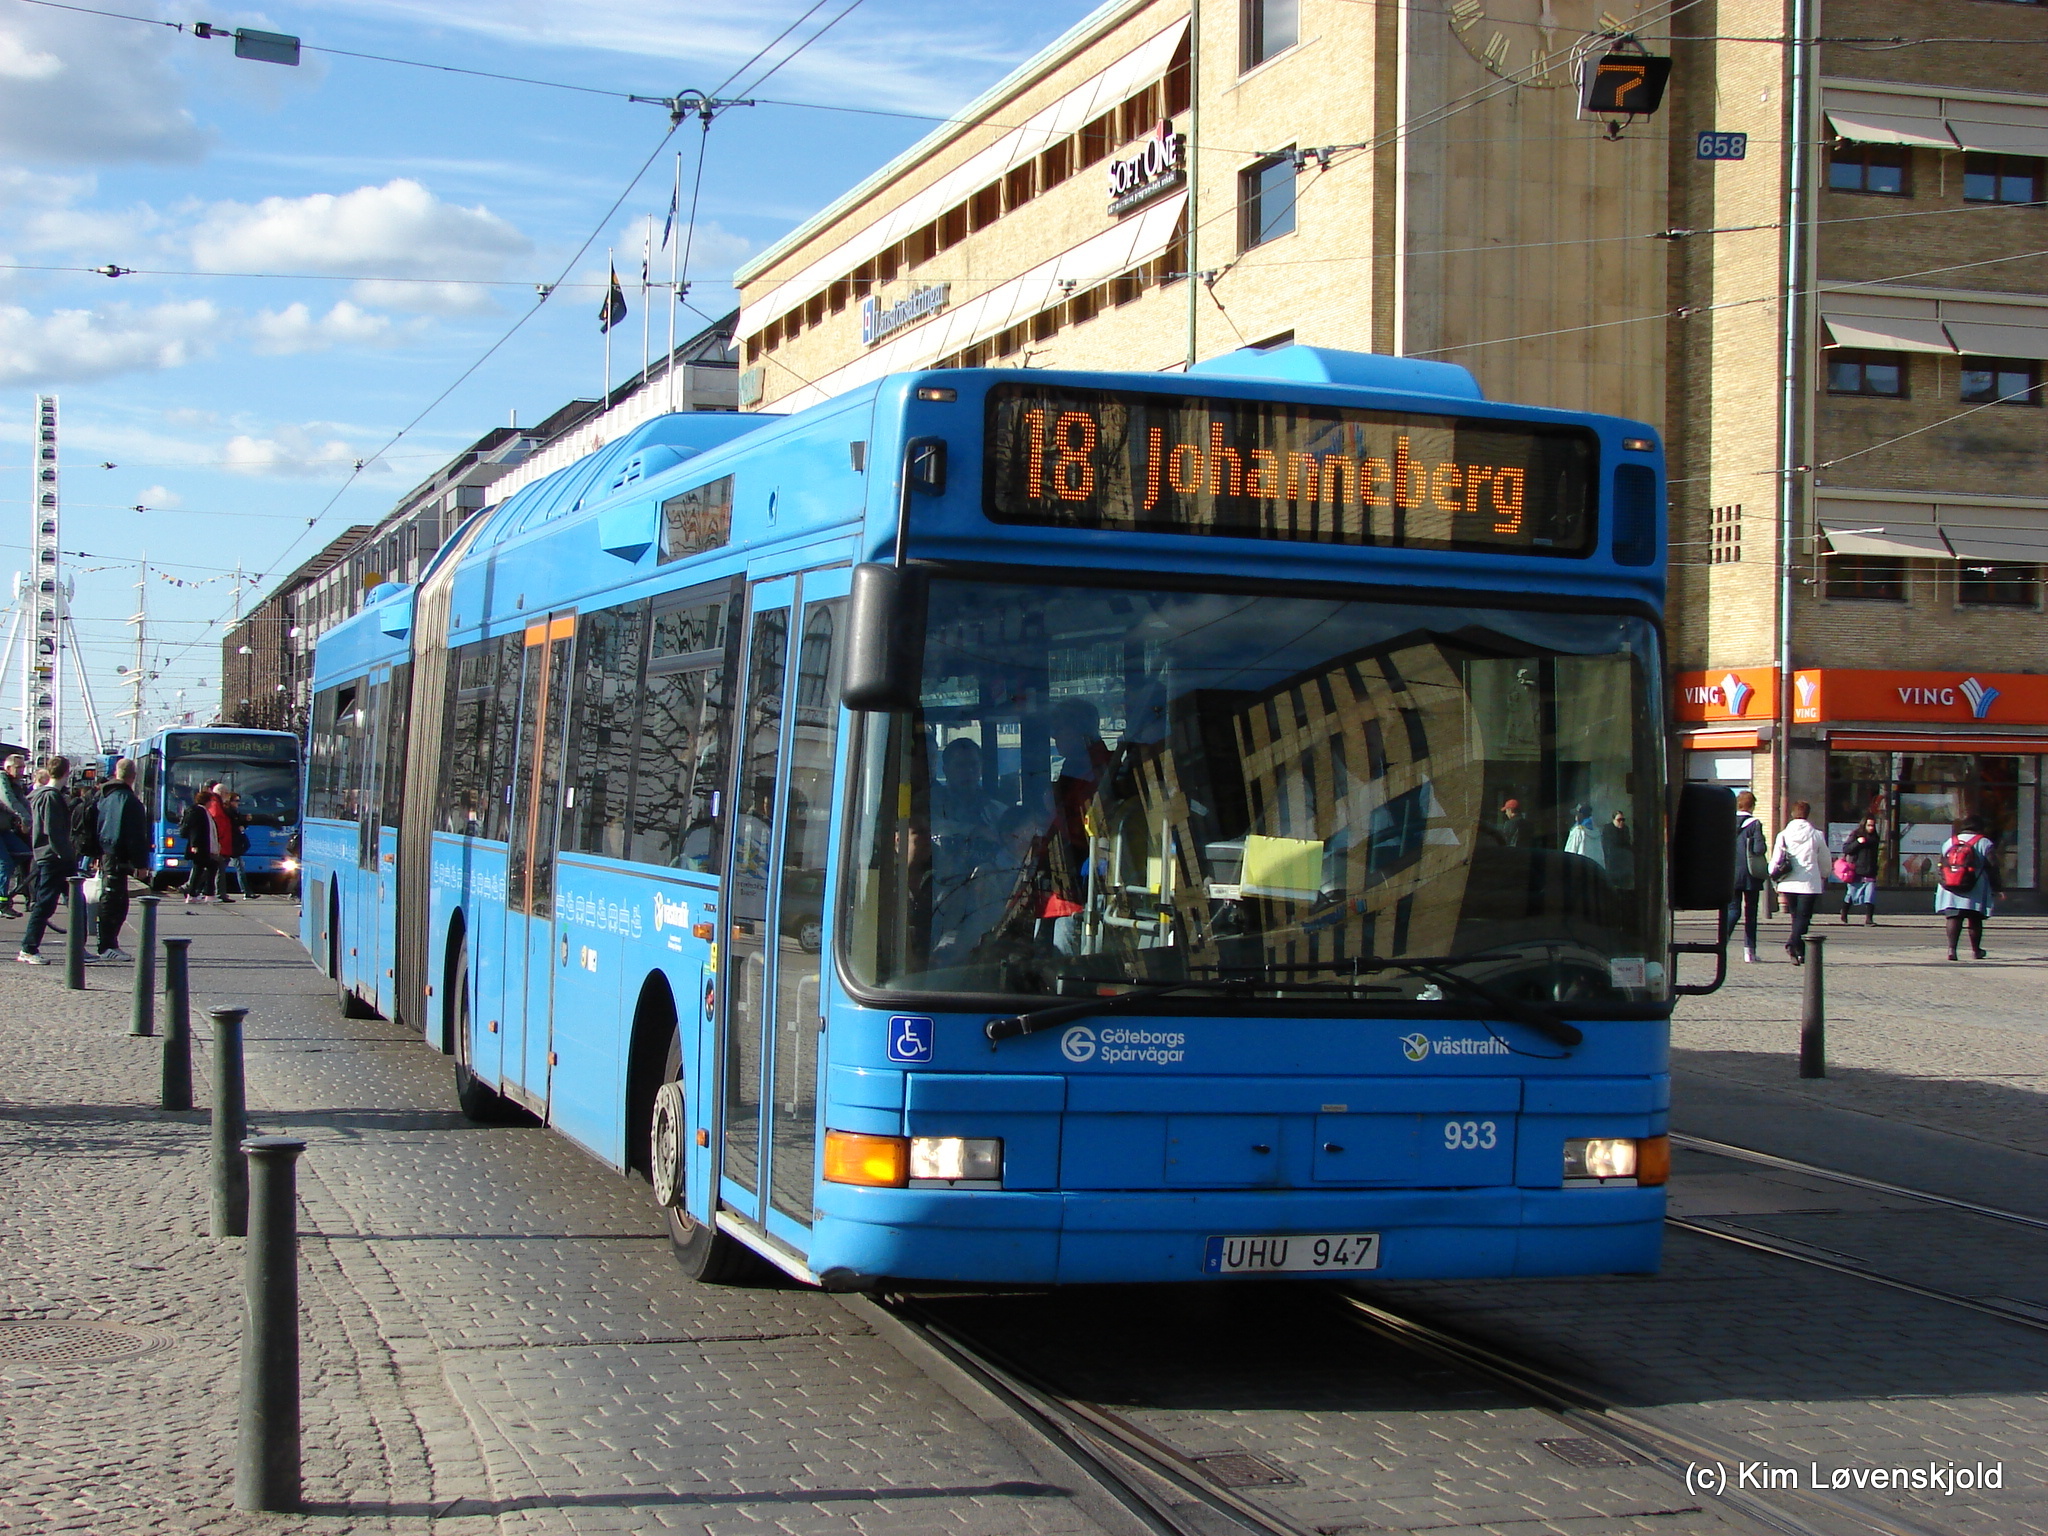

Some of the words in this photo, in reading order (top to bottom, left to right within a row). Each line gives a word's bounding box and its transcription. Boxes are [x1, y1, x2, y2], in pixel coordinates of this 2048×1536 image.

[1598, 64, 1645, 107] 7
[1699, 135, 1745, 157] 658
[1026, 409, 1096, 501] 18
[1685, 686, 1719, 704] VING
[1897, 687, 1954, 706] VING
[1795, 707, 1817, 718] VING
[180, 739, 201, 752] 42
[1100, 1029, 1185, 1048] Göteborgs
[1433, 1037, 1510, 1055] västtrafik
[1100, 1045, 1185, 1065] Spårvägar
[1444, 1121, 1497, 1150] 933
[1227, 1239, 1288, 1268] UHU
[1313, 1237, 1373, 1266] 947
